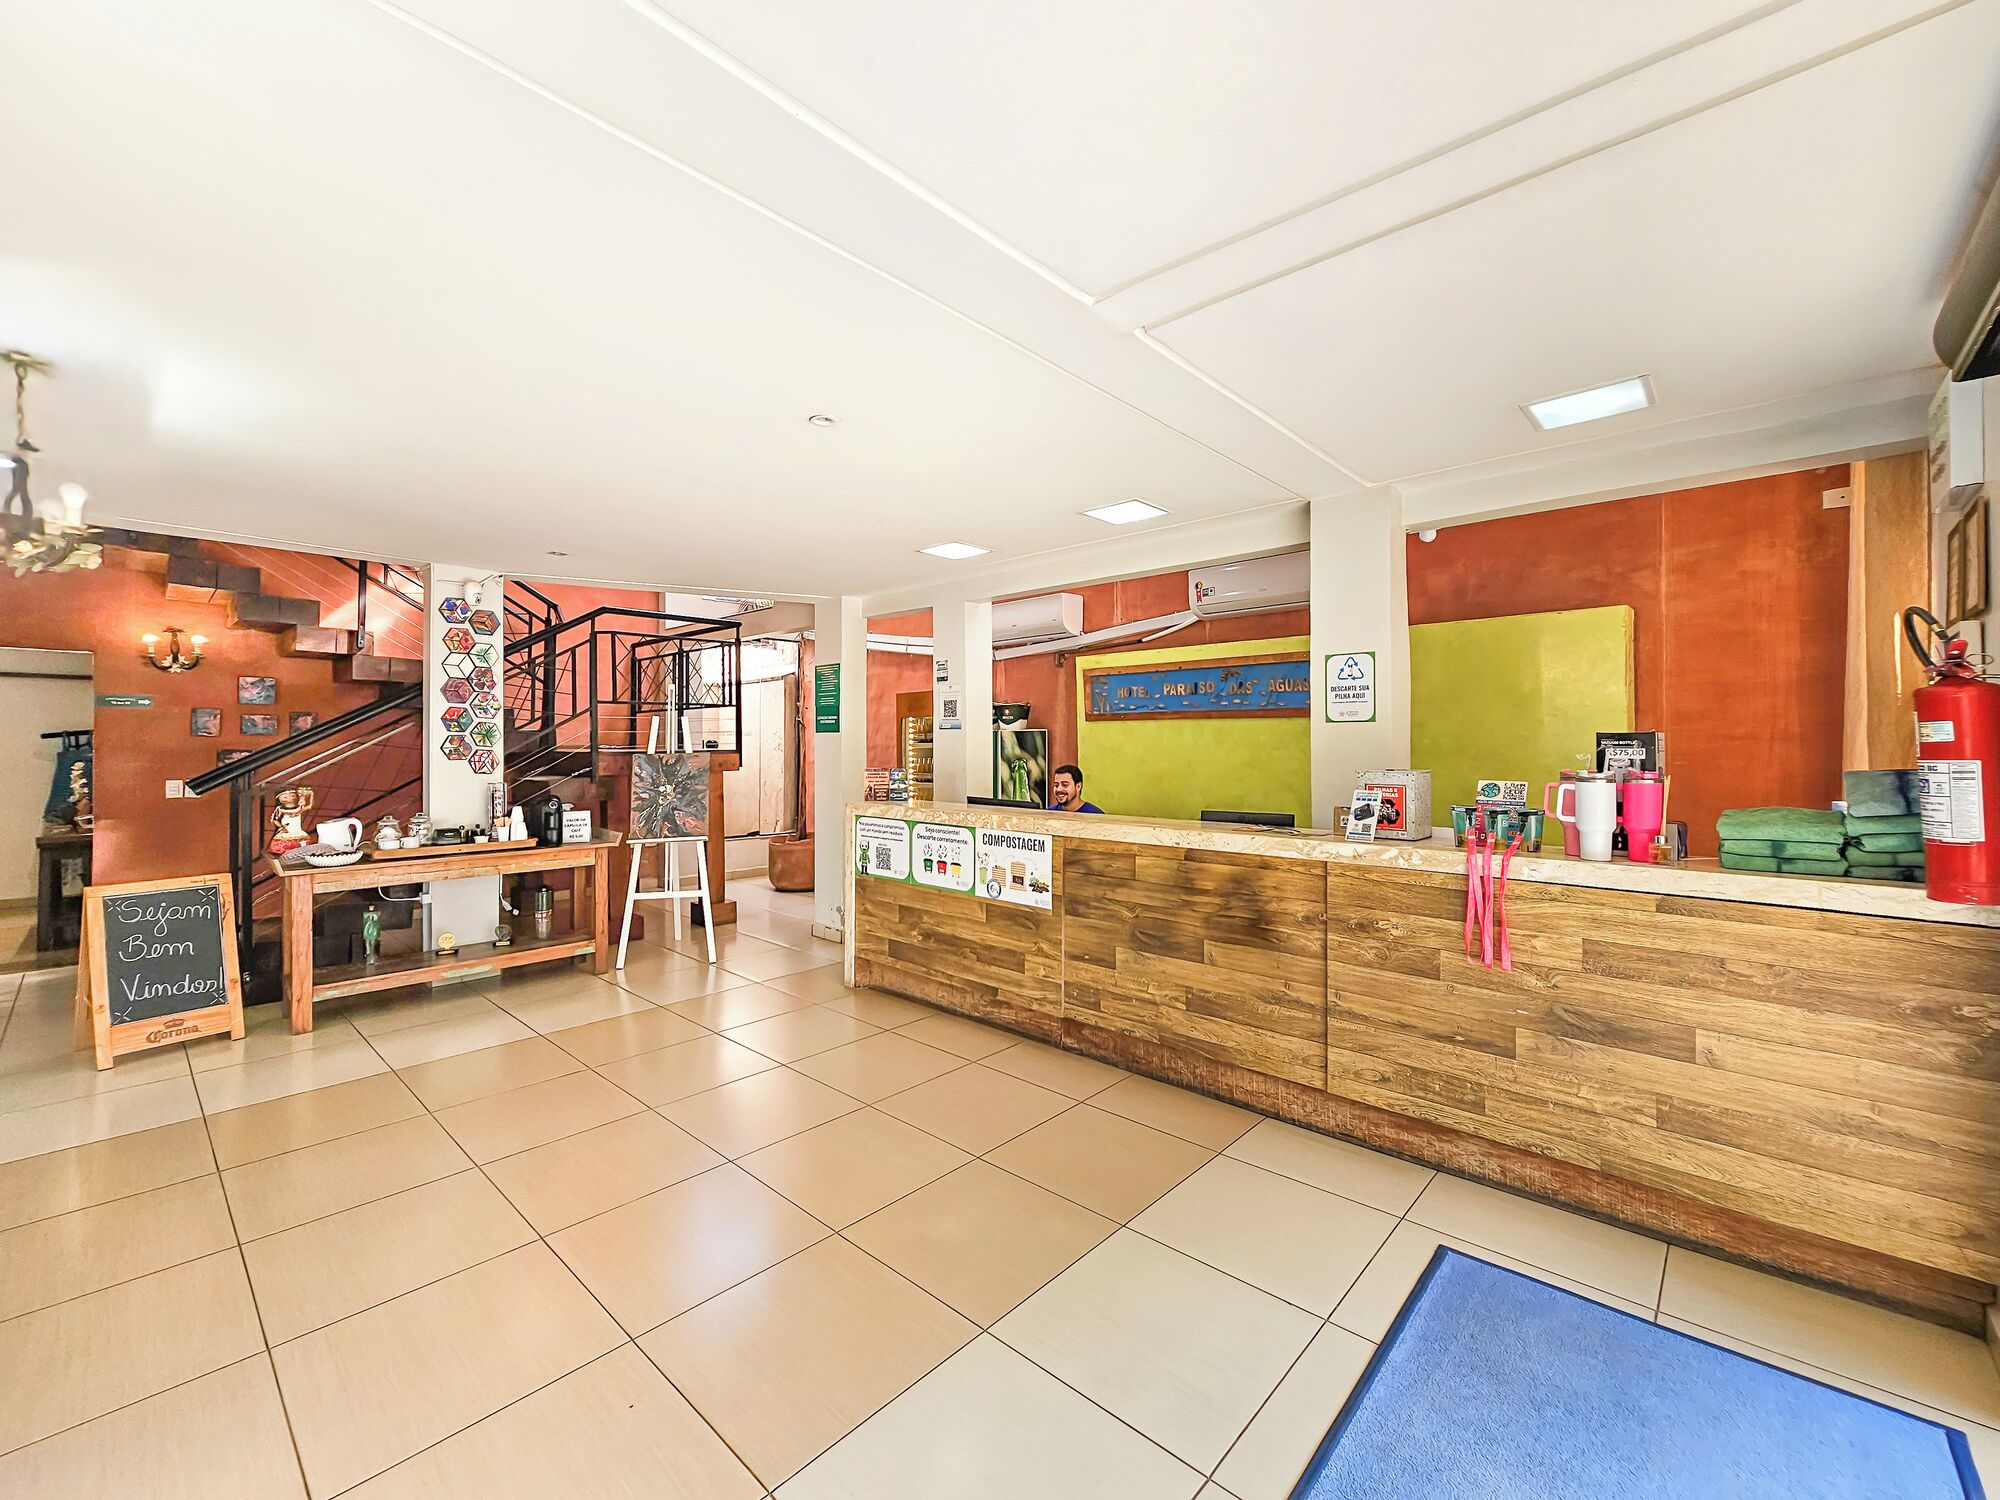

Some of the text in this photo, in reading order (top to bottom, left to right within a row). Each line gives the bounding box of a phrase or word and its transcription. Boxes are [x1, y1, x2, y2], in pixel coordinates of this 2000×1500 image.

[1117, 685, 1150, 699] HOTEL
[1163, 681, 1216, 696] PARAISO
[1229, 681, 1253, 695] DAS
[916, 833, 936, 841] Descarte
[924, 826, 935, 834] Seja
[982, 833, 1045, 853] COMPOSTAGEM
[118, 899, 212, 937] Sejam
[118, 934, 195, 962] Bem
[145, 1024, 202, 1044] Corona
